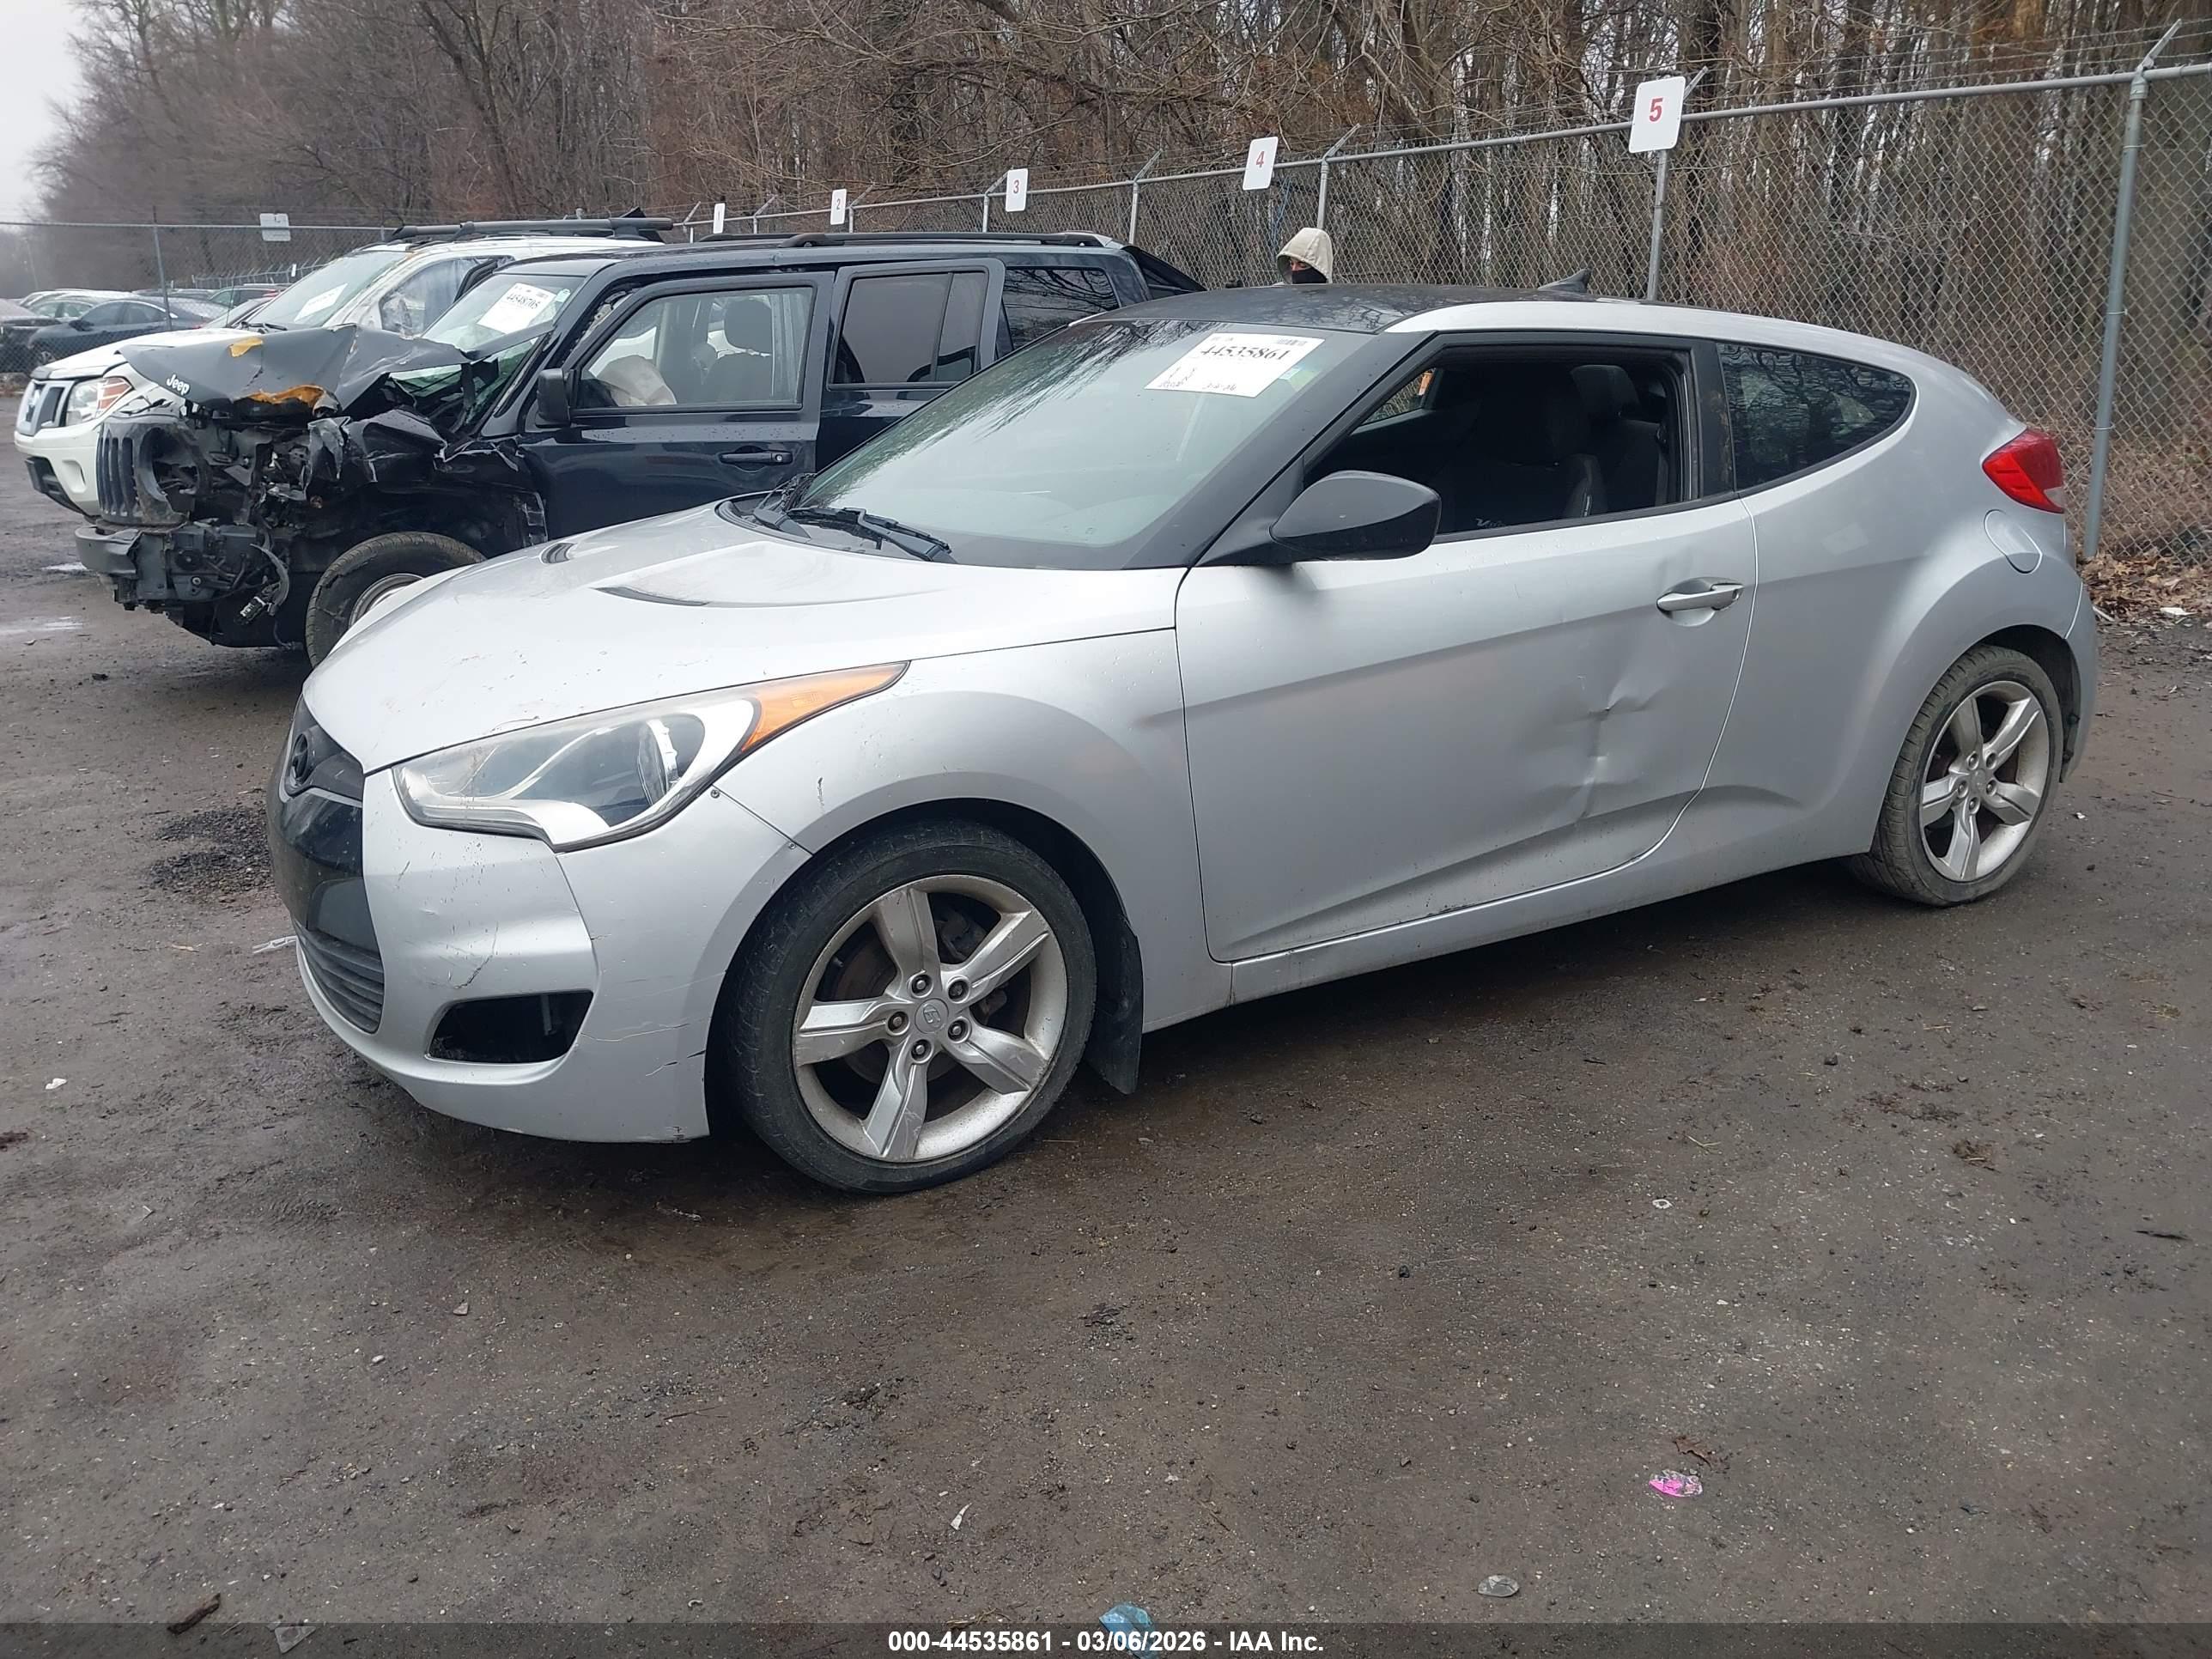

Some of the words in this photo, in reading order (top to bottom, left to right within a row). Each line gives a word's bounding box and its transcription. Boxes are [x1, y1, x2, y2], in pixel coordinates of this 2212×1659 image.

[1649, 97, 1663, 122] 5
[1255, 150, 1265, 168] 4
[1012, 179, 1020, 194] 3
[836, 198, 842, 210] 2
[1200, 345, 1291, 361] 44535861
[166, 374, 190, 396] Jeep
